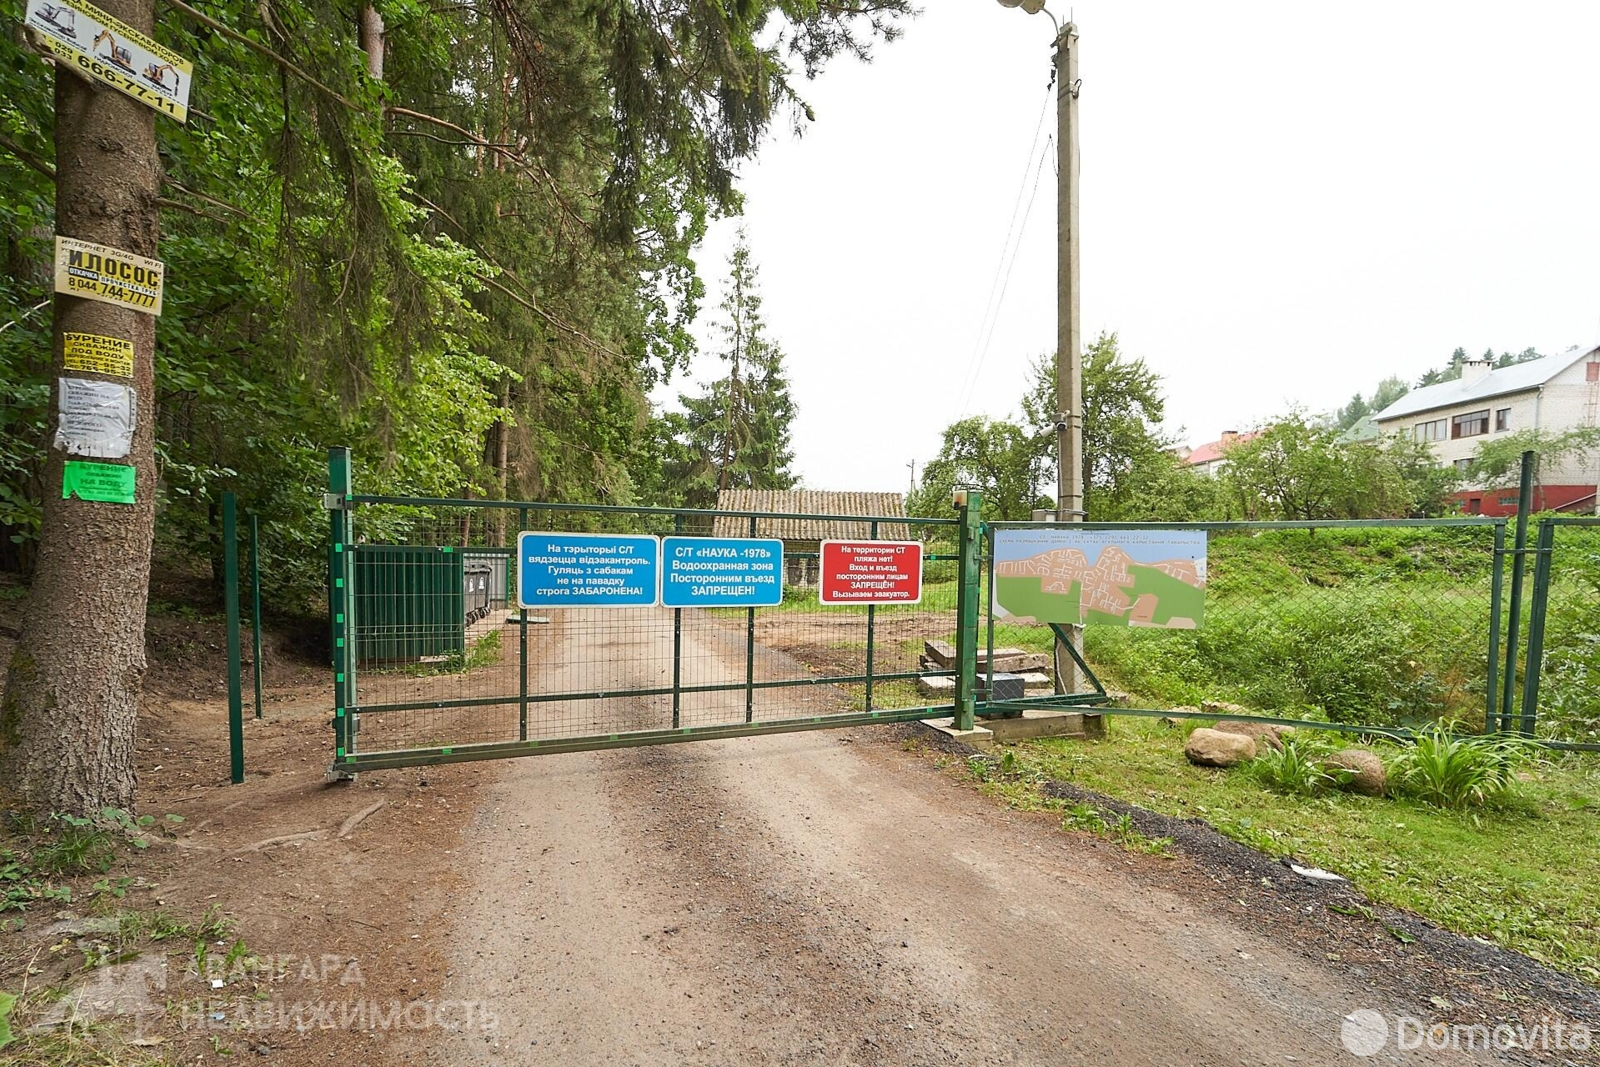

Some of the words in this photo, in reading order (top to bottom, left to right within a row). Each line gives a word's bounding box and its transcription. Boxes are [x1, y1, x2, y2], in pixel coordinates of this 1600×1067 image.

[86, 3, 184, 66] МИНИ-ЭКСКАВАТОРОВ
[54, 48, 72, 60] 033
[55, 42, 73, 54] 029
[78, 56, 176, 114] 666-77-11
[62, 239, 107, 254] ИНТЕРНЕТ
[110, 250, 134, 260] 3G/4G
[69, 250, 158, 287] ИЛОСОС
[69, 266, 98, 280] ОТКАЧКА
[100, 276, 140, 292] ПРОЧИСТКА
[68, 278, 76, 287] 8
[78, 279, 98, 292] 044
[100, 282, 156, 307] 744-7777
[66, 334, 131, 350] БУРЕНИЕ
[73, 342, 122, 353] СКВАЖИН
[96, 350, 124, 359] ВОДУ
[80, 360, 131, 372] 652-95-32
[548, 544, 561, 553] На
[563, 546, 616, 555] тэрыторыі
[618, 545, 634, 554] С/Т
[675, 547, 694, 558] С/Т
[696, 548, 738, 558] «НАУКА
[740, 548, 771, 558] -1978»
[528, 556, 576, 564] вядзецца
[579, 556, 651, 566] відэакантроль.
[672, 560, 748, 572] Водоохранная
[548, 566, 584, 576] Гуляць
[594, 566, 634, 575] сабакам
[586, 578, 625, 587] павадку
[670, 573, 742, 584] Посторонним
[744, 575, 775, 584] въезд
[850, 580, 895, 589] ЗАПРЕЩЁН!
[536, 588, 570, 596] строга
[572, 587, 643, 595] ЗАБАРОНЕНА!
[691, 586, 755, 596] ЗАПРЕЩЕН!
